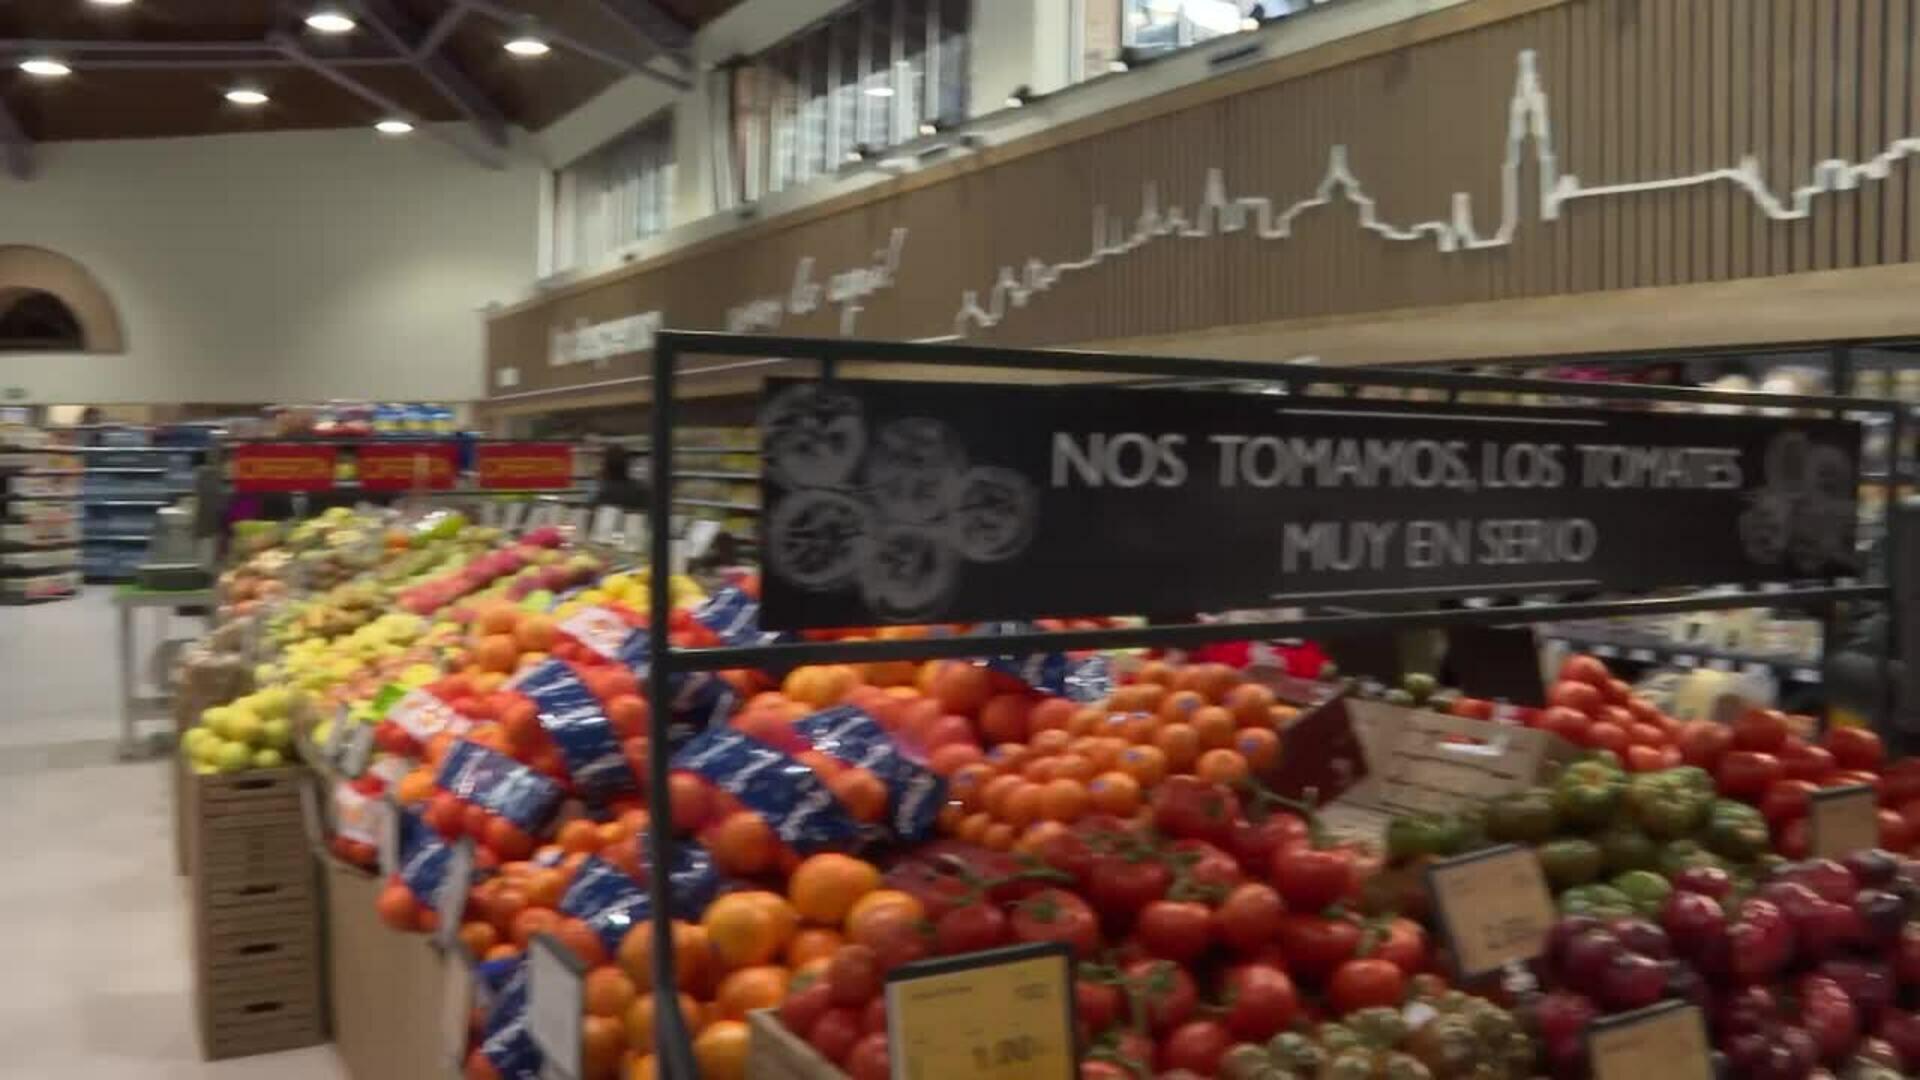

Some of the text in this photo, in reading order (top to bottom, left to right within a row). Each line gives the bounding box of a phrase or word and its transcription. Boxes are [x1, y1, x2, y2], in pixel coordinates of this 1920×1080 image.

[1051, 432, 1188, 488] NOS
[1482, 442, 1567, 488] LOS
[1574, 444, 1744, 489] TOMATES
[1281, 516, 1598, 573] MUY EN SERIO
